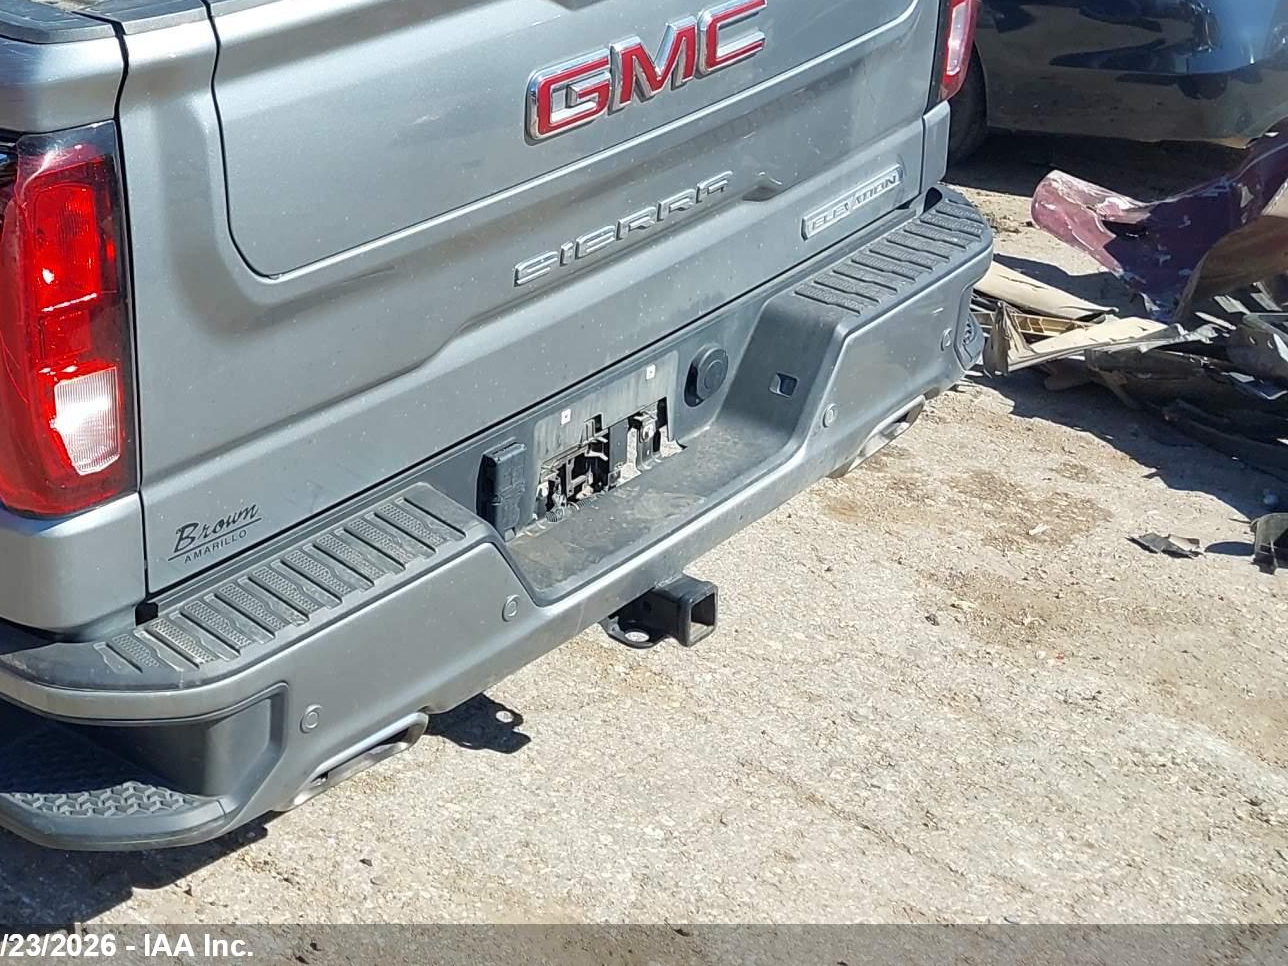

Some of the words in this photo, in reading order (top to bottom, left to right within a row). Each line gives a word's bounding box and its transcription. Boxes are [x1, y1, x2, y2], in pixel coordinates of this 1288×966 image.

[513, 170, 734, 287] SIERRA
[807, 171, 899, 233] ELEVATION
[173, 504, 259, 553] Brown
[184, 529, 248, 564] AMARILLO
